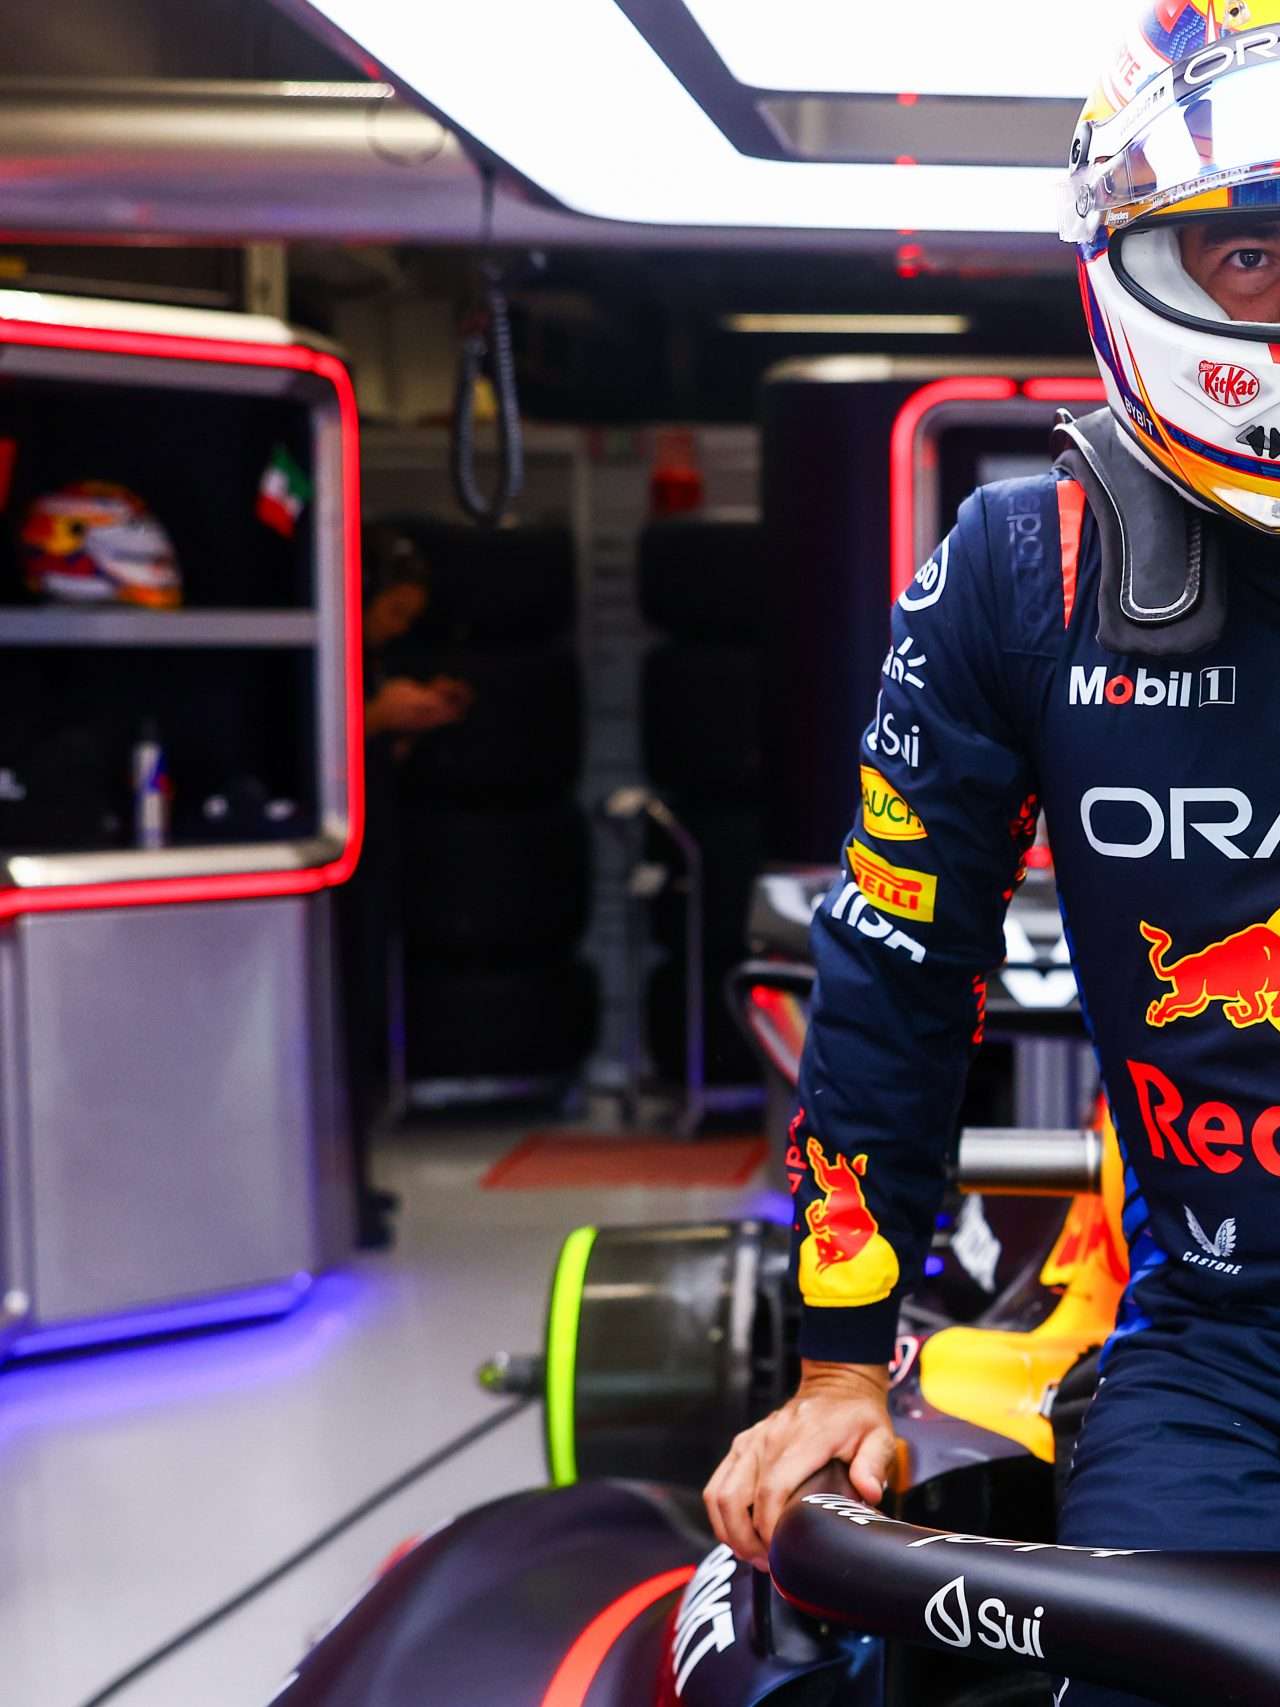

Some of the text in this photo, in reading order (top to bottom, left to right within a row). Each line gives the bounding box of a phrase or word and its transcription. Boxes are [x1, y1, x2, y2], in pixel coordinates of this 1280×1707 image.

[1203, 365, 1257, 405] KitKat
[1124, 395, 1154, 436] BYBIT
[1069, 664, 1192, 707] Mobil
[1182, 1249, 1243, 1275] CASTORE
[977, 1597, 1045, 1659] Sui
